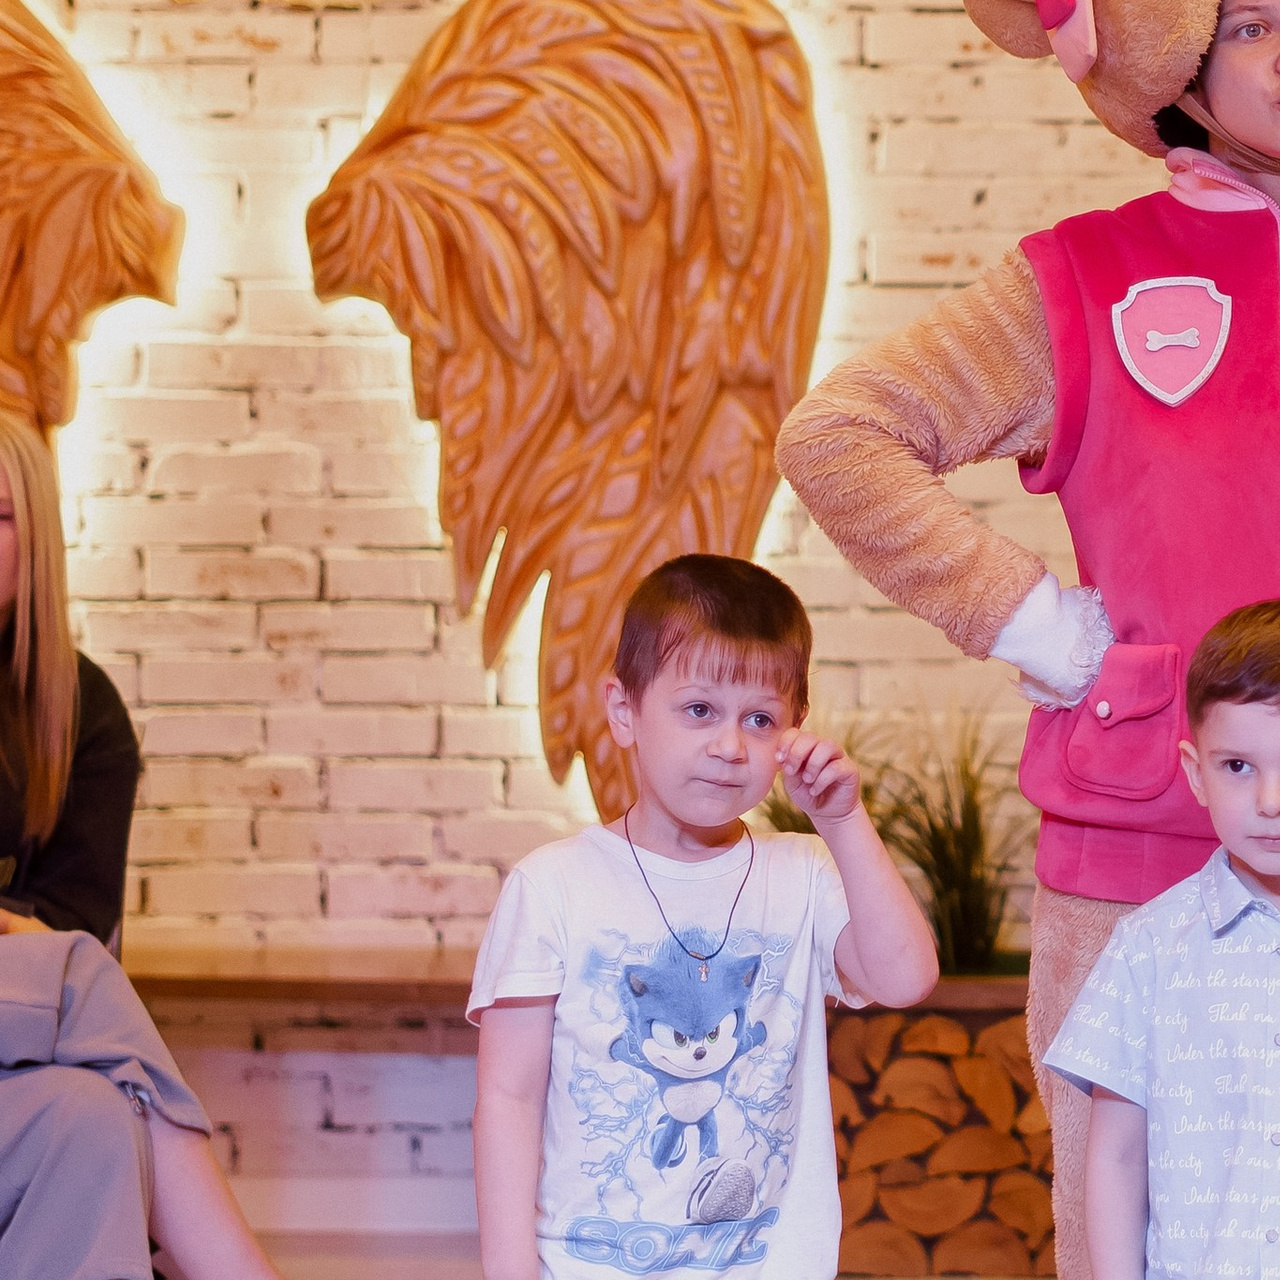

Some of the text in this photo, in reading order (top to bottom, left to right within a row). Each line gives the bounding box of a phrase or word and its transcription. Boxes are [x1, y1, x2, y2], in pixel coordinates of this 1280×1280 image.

[1211, 935, 1252, 955] Think
[1165, 971, 1201, 991] Under
[1206, 969, 1228, 988] the
[1165, 1008, 1189, 1034] city
[1208, 1002, 1250, 1023] Think
[1167, 1043, 1204, 1063] Under
[1209, 1038, 1229, 1059] the
[1169, 1079, 1195, 1106] city
[1214, 1073, 1248, 1095] Think
[1173, 1114, 1214, 1134] Under
[1217, 1110, 1236, 1131] the
[1159, 1149, 1175, 1170] the
[1178, 1151, 1204, 1177] city
[1184, 1185, 1220, 1205] Under
[566, 1207, 779, 1275] SONIC
[1167, 1220, 1186, 1239] the
